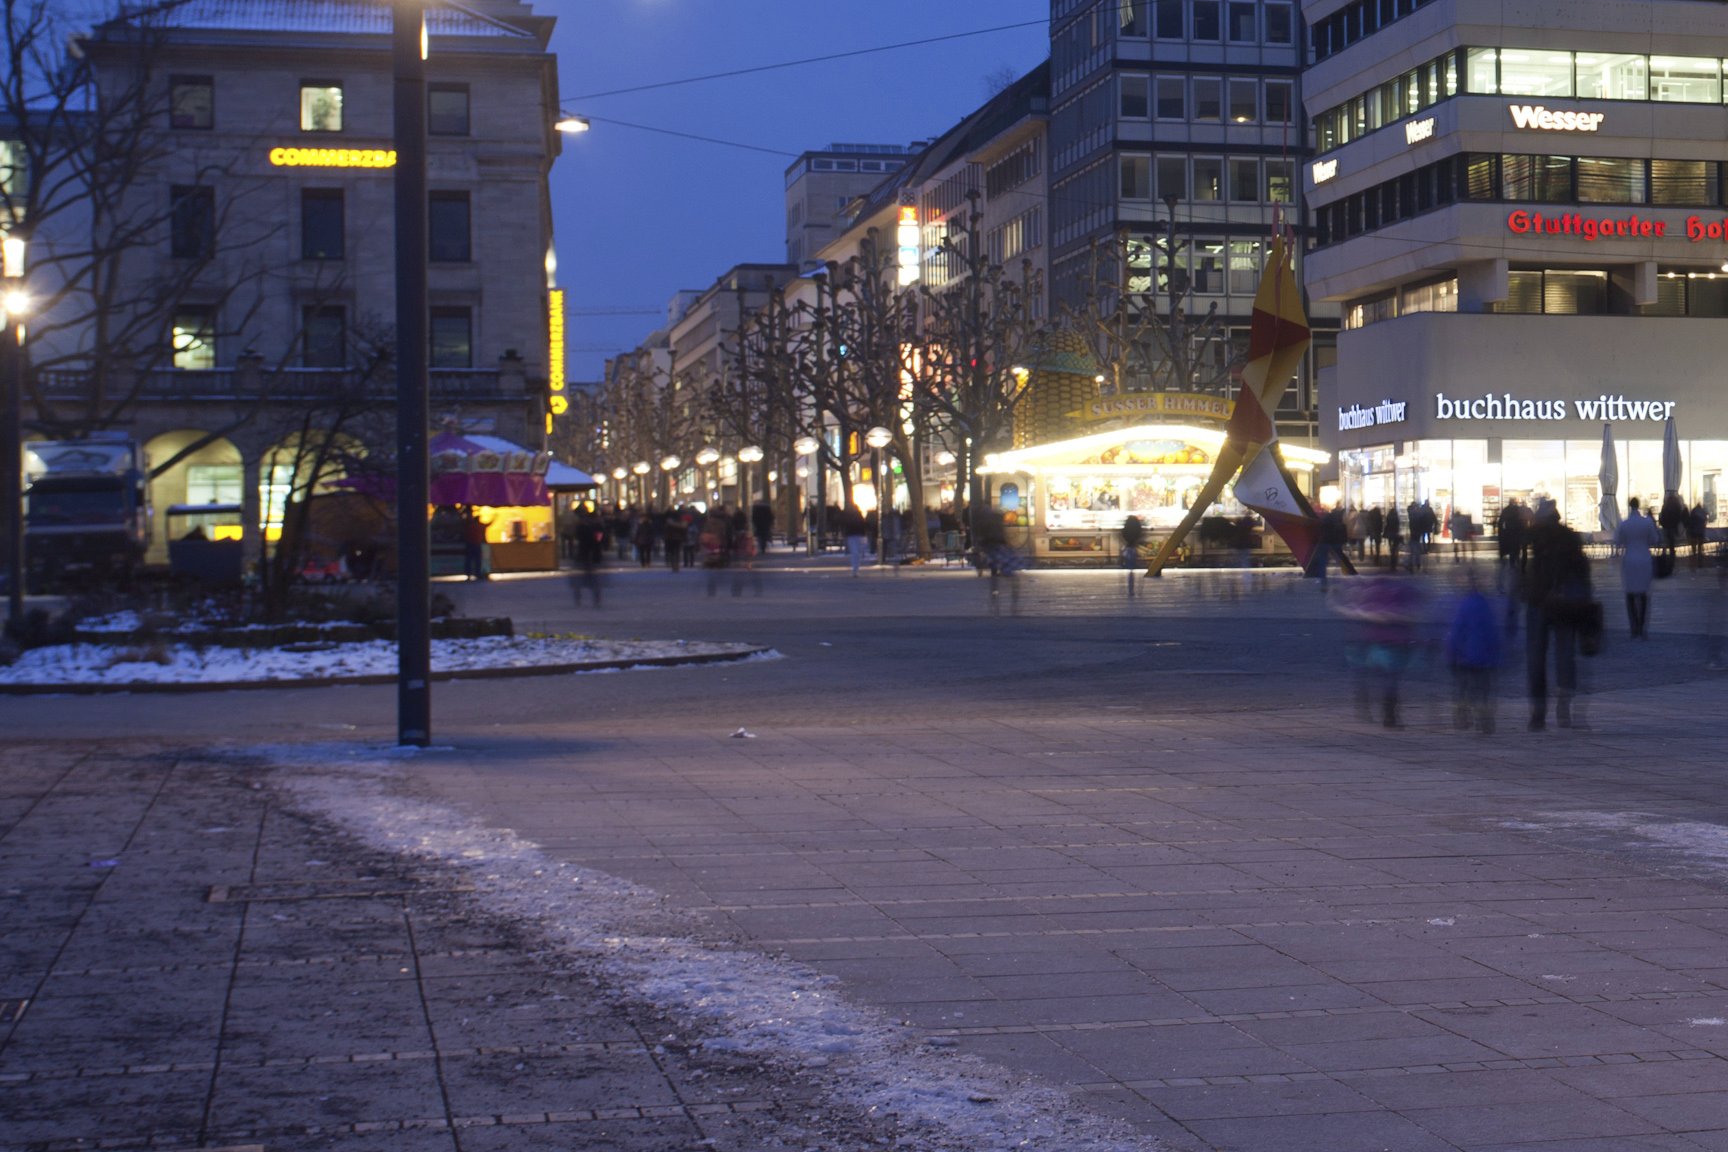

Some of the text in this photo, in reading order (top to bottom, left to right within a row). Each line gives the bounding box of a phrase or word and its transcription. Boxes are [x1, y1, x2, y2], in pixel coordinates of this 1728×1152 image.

[1405, 116, 1436, 145] Wesser
[1509, 104, 1605, 132] Wesser
[1312, 157, 1340, 185] Wesser
[1508, 209, 1666, 241] Stuttgarter
[1165, 397, 1231, 417] HIMMEL
[1338, 399, 1406, 431] buchhaus wittwer
[1436, 393, 1676, 422] buchhaus wittwer
